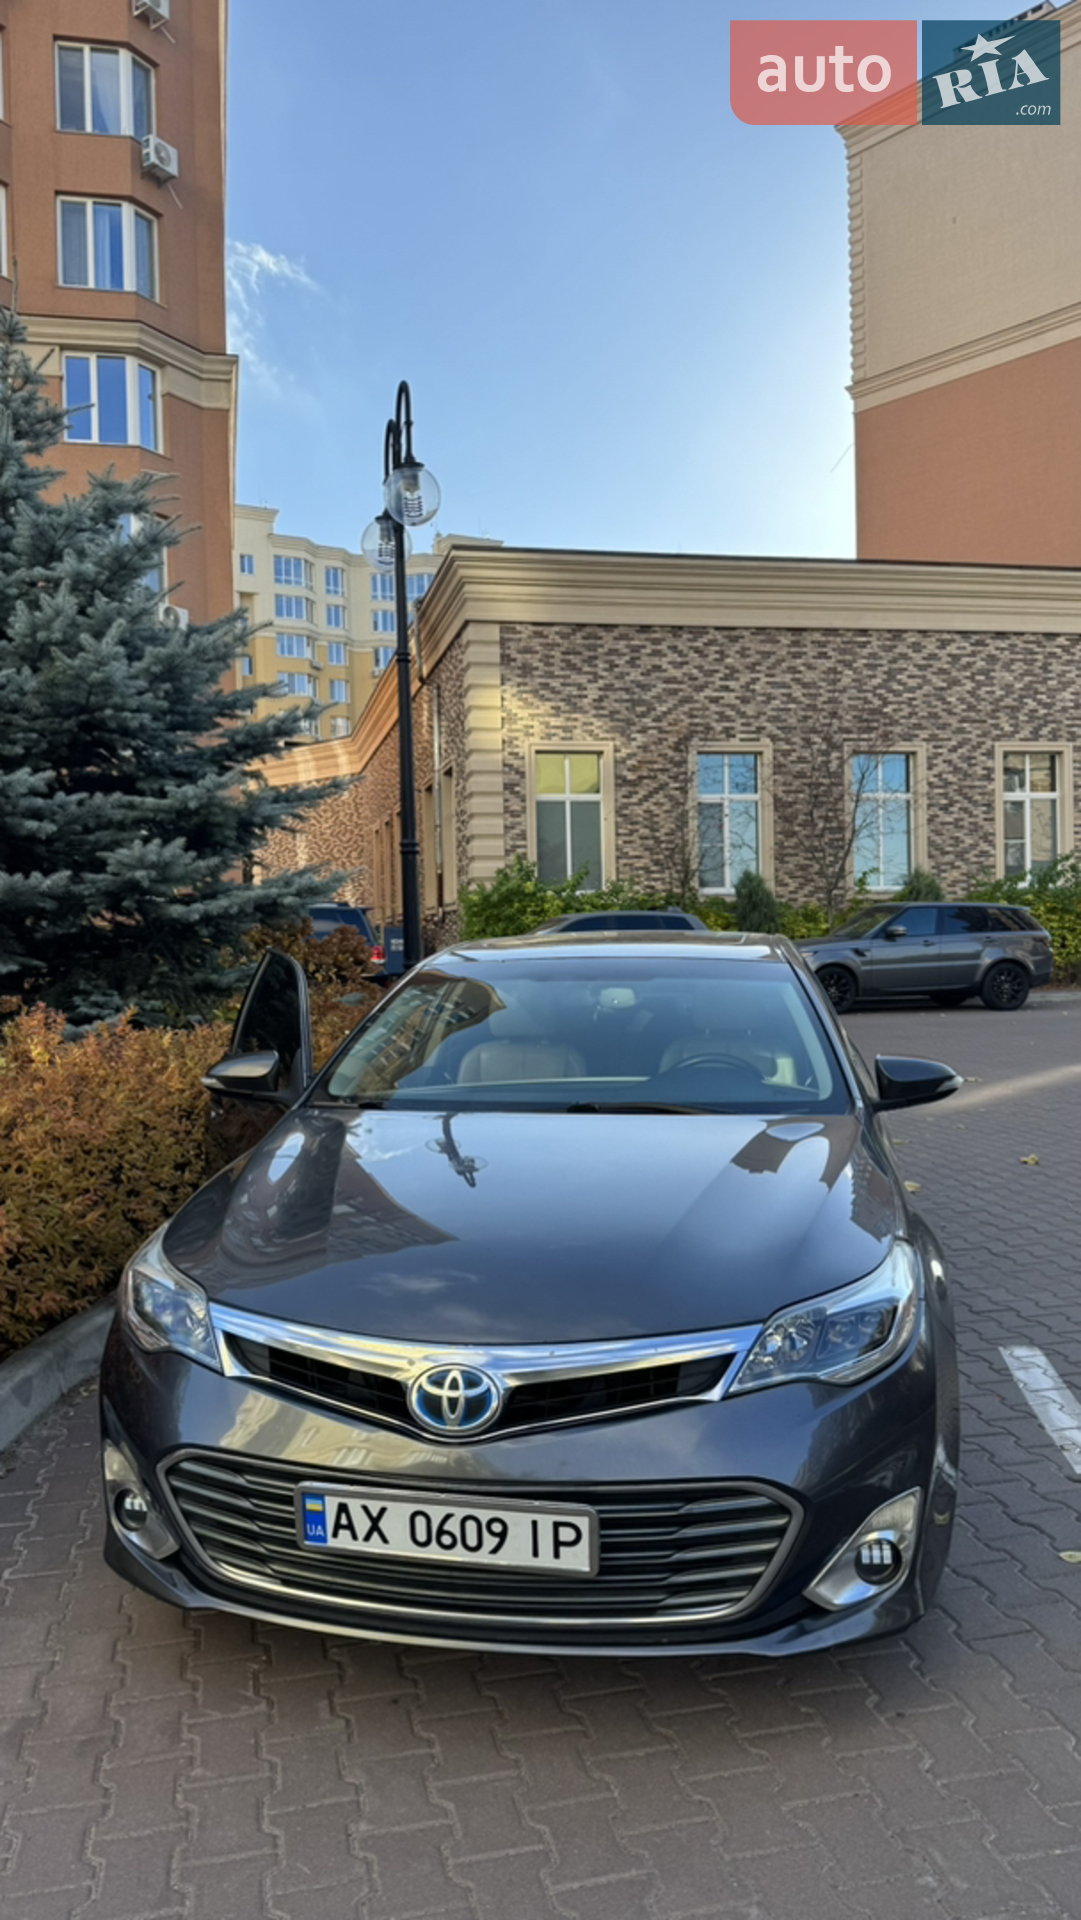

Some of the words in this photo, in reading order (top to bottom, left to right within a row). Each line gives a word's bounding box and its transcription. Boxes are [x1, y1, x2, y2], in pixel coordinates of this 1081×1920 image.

[306, 1523, 324, 1537] UA
[331, 1502, 389, 1544] AX
[409, 1510, 508, 1555] 0609
[531, 1520, 583, 1559] IP
